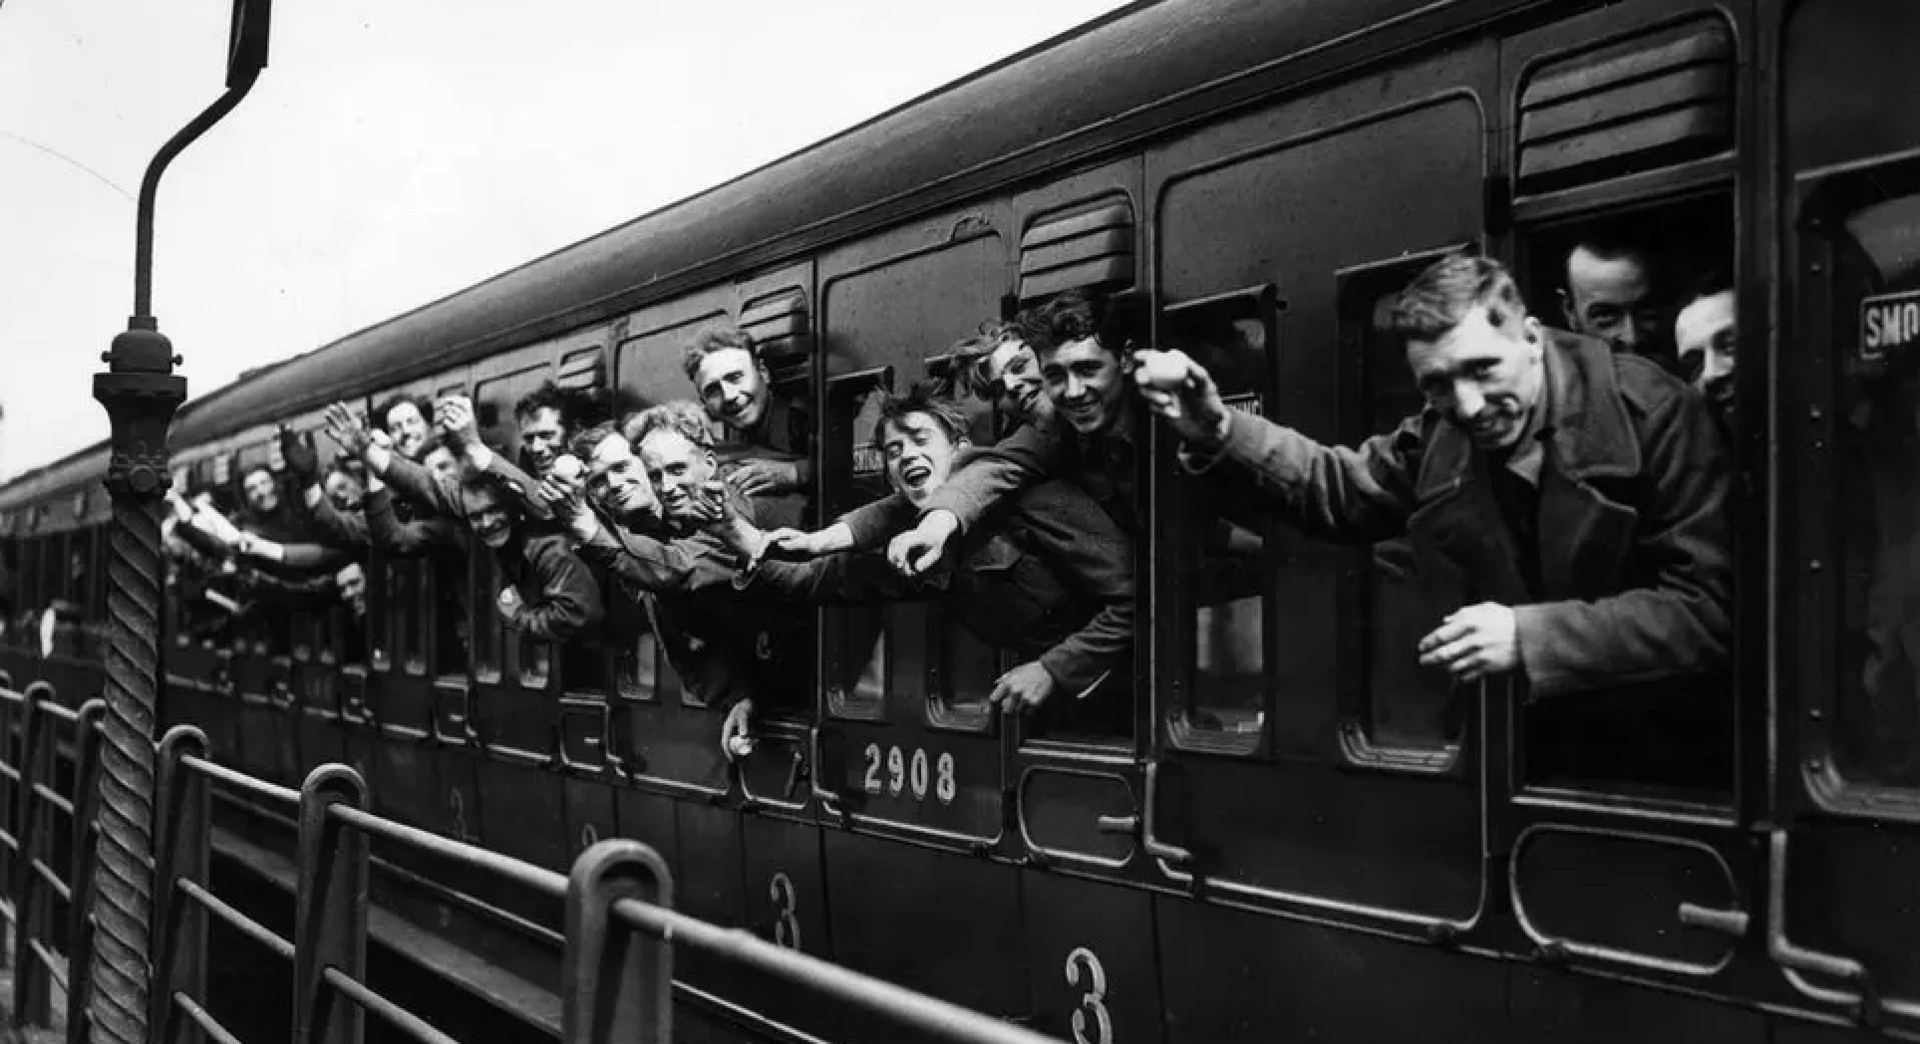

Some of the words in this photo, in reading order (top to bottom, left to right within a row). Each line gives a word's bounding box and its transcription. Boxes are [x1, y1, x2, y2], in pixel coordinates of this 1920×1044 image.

[864, 743, 956, 805] 2908
[770, 872, 800, 949] 3
[1065, 946, 1112, 1044] 3
